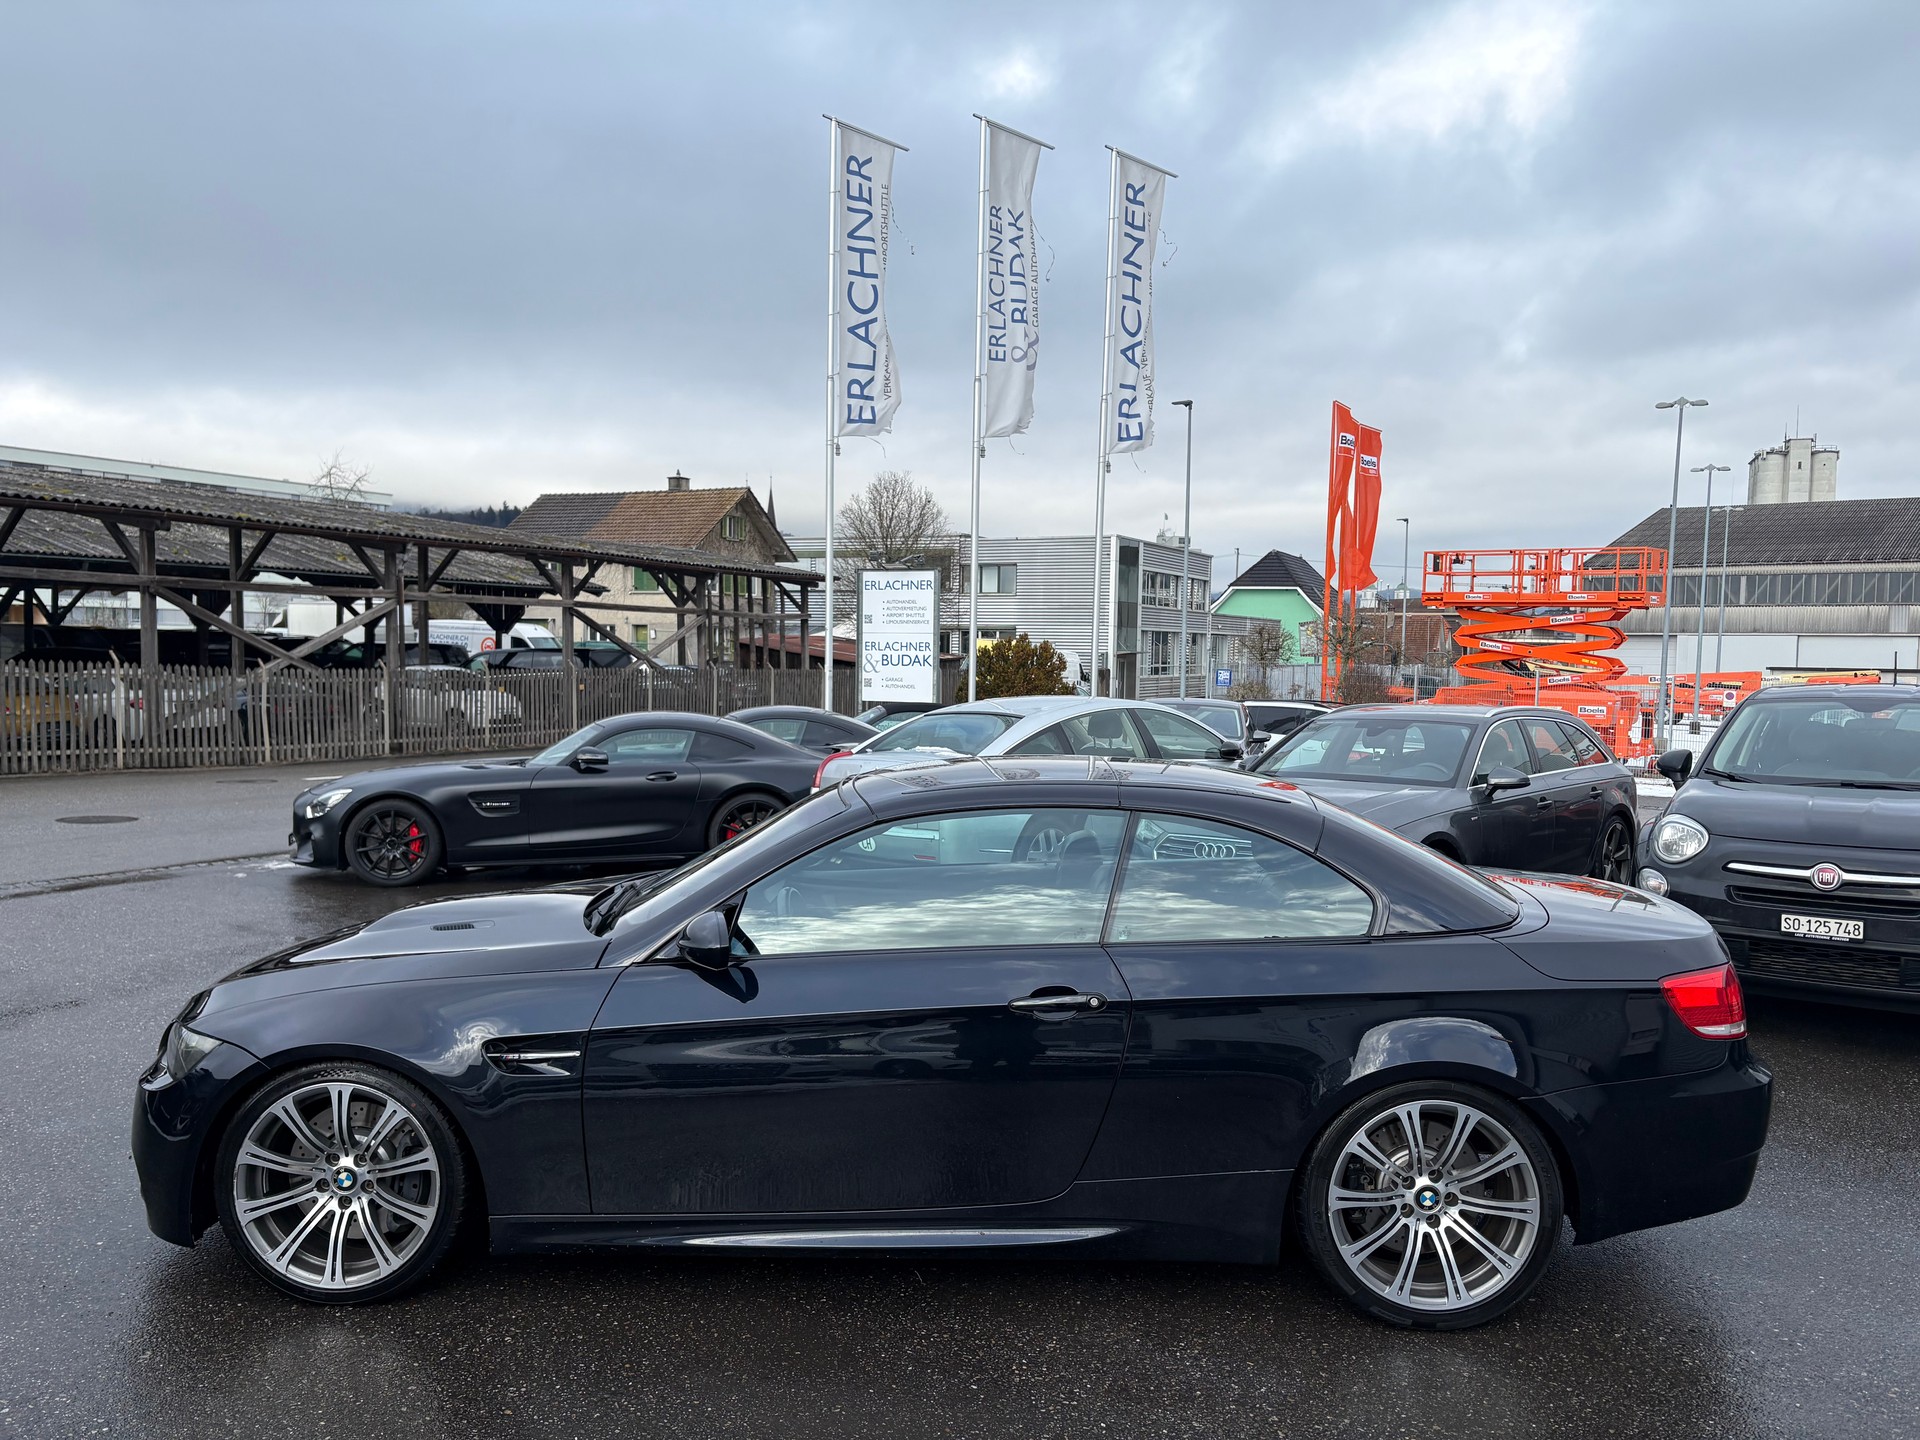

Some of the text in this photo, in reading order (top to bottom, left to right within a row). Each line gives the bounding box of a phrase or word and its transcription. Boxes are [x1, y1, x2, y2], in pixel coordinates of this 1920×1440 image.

[846, 155, 879, 424] ERLACHNER
[988, 205, 1007, 363] ERLACHNER
[1118, 182, 1146, 442] ERLACHNER
[864, 580, 934, 591] ERLACHNER
[1550, 616, 1573, 624] Boels
[864, 641, 932, 652] ERLACHNER
[1480, 641, 1501, 650] Boels
[863, 653, 932, 674] & BUDAK
[1548, 676, 1570, 684] Boels
[1579, 706, 1605, 714] Boels
[1819, 872, 1834, 883] FIAT
